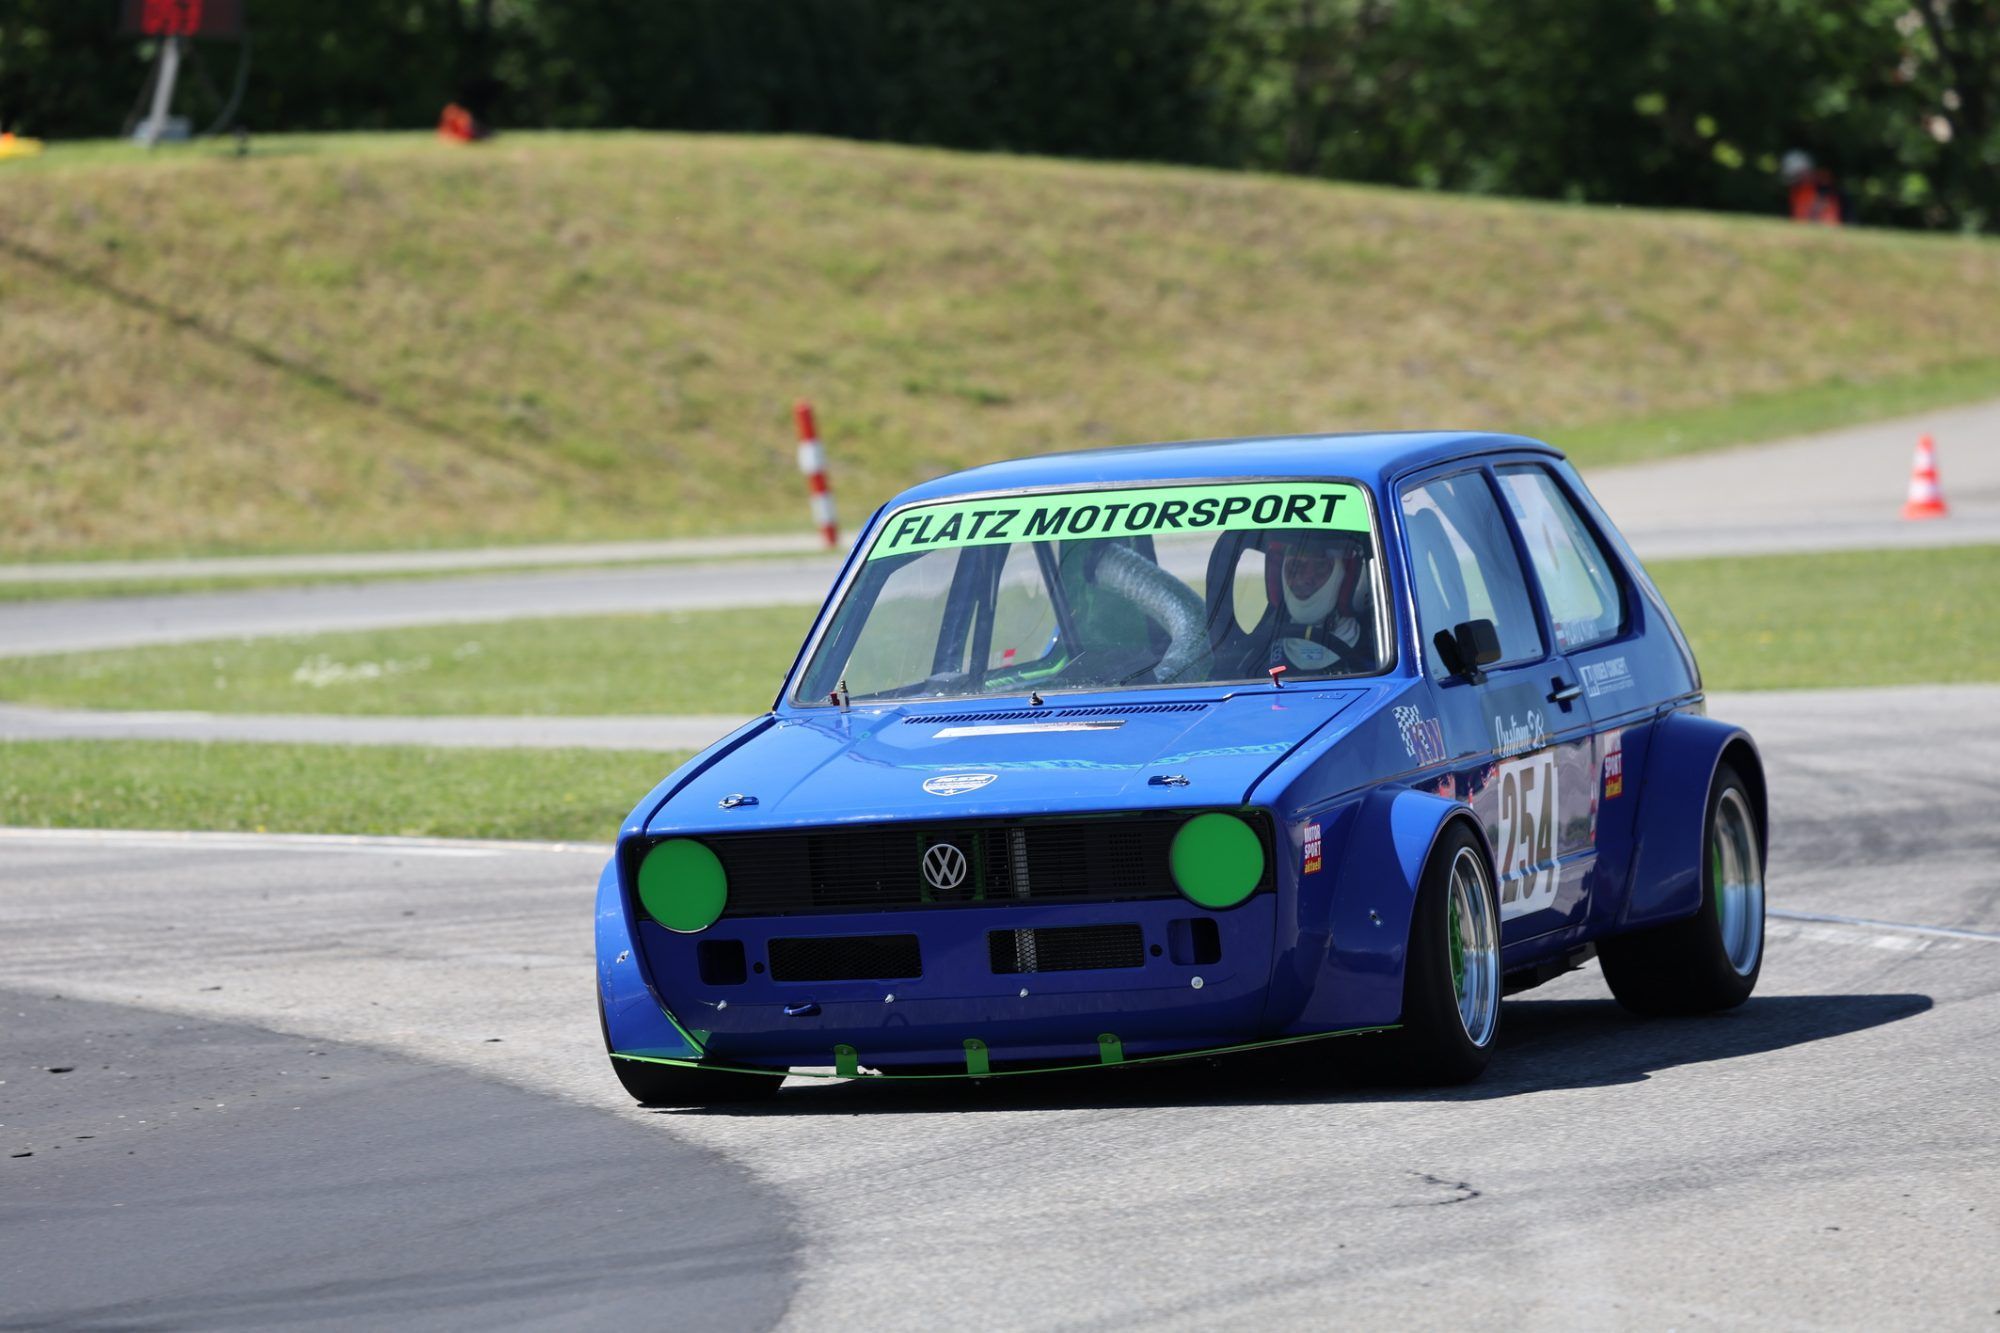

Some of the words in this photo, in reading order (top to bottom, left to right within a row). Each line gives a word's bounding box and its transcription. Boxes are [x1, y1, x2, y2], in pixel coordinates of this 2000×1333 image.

[889, 509, 1021, 548] FLATZ
[1023, 494, 1347, 536] MOTORSPORT
[1304, 840, 1321, 860] SPORT
[1501, 762, 1556, 905] 254
